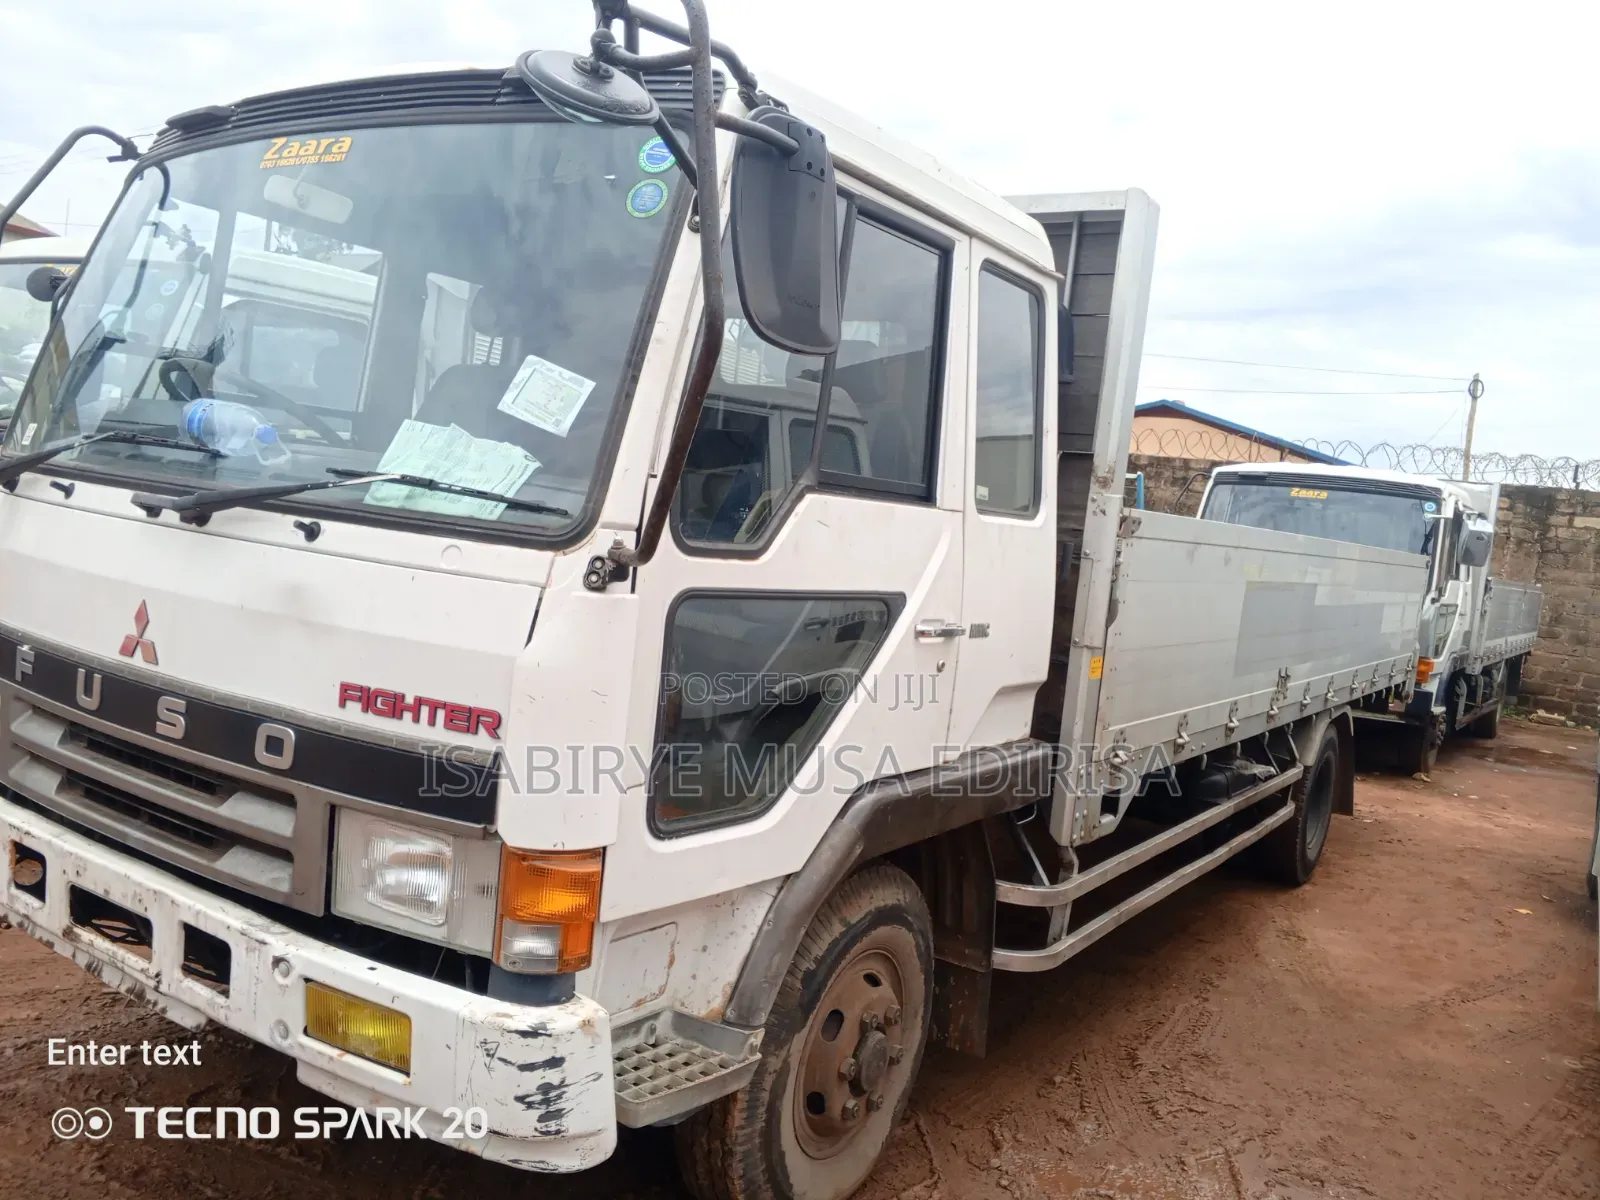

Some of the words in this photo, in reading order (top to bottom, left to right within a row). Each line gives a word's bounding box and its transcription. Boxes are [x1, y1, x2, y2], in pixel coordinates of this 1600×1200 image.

[263, 136, 353, 160] Zaara
[1290, 487, 1328, 498] Zaara
[15, 644, 295, 770] FUSO
[339, 681, 502, 739] FIGHTER
